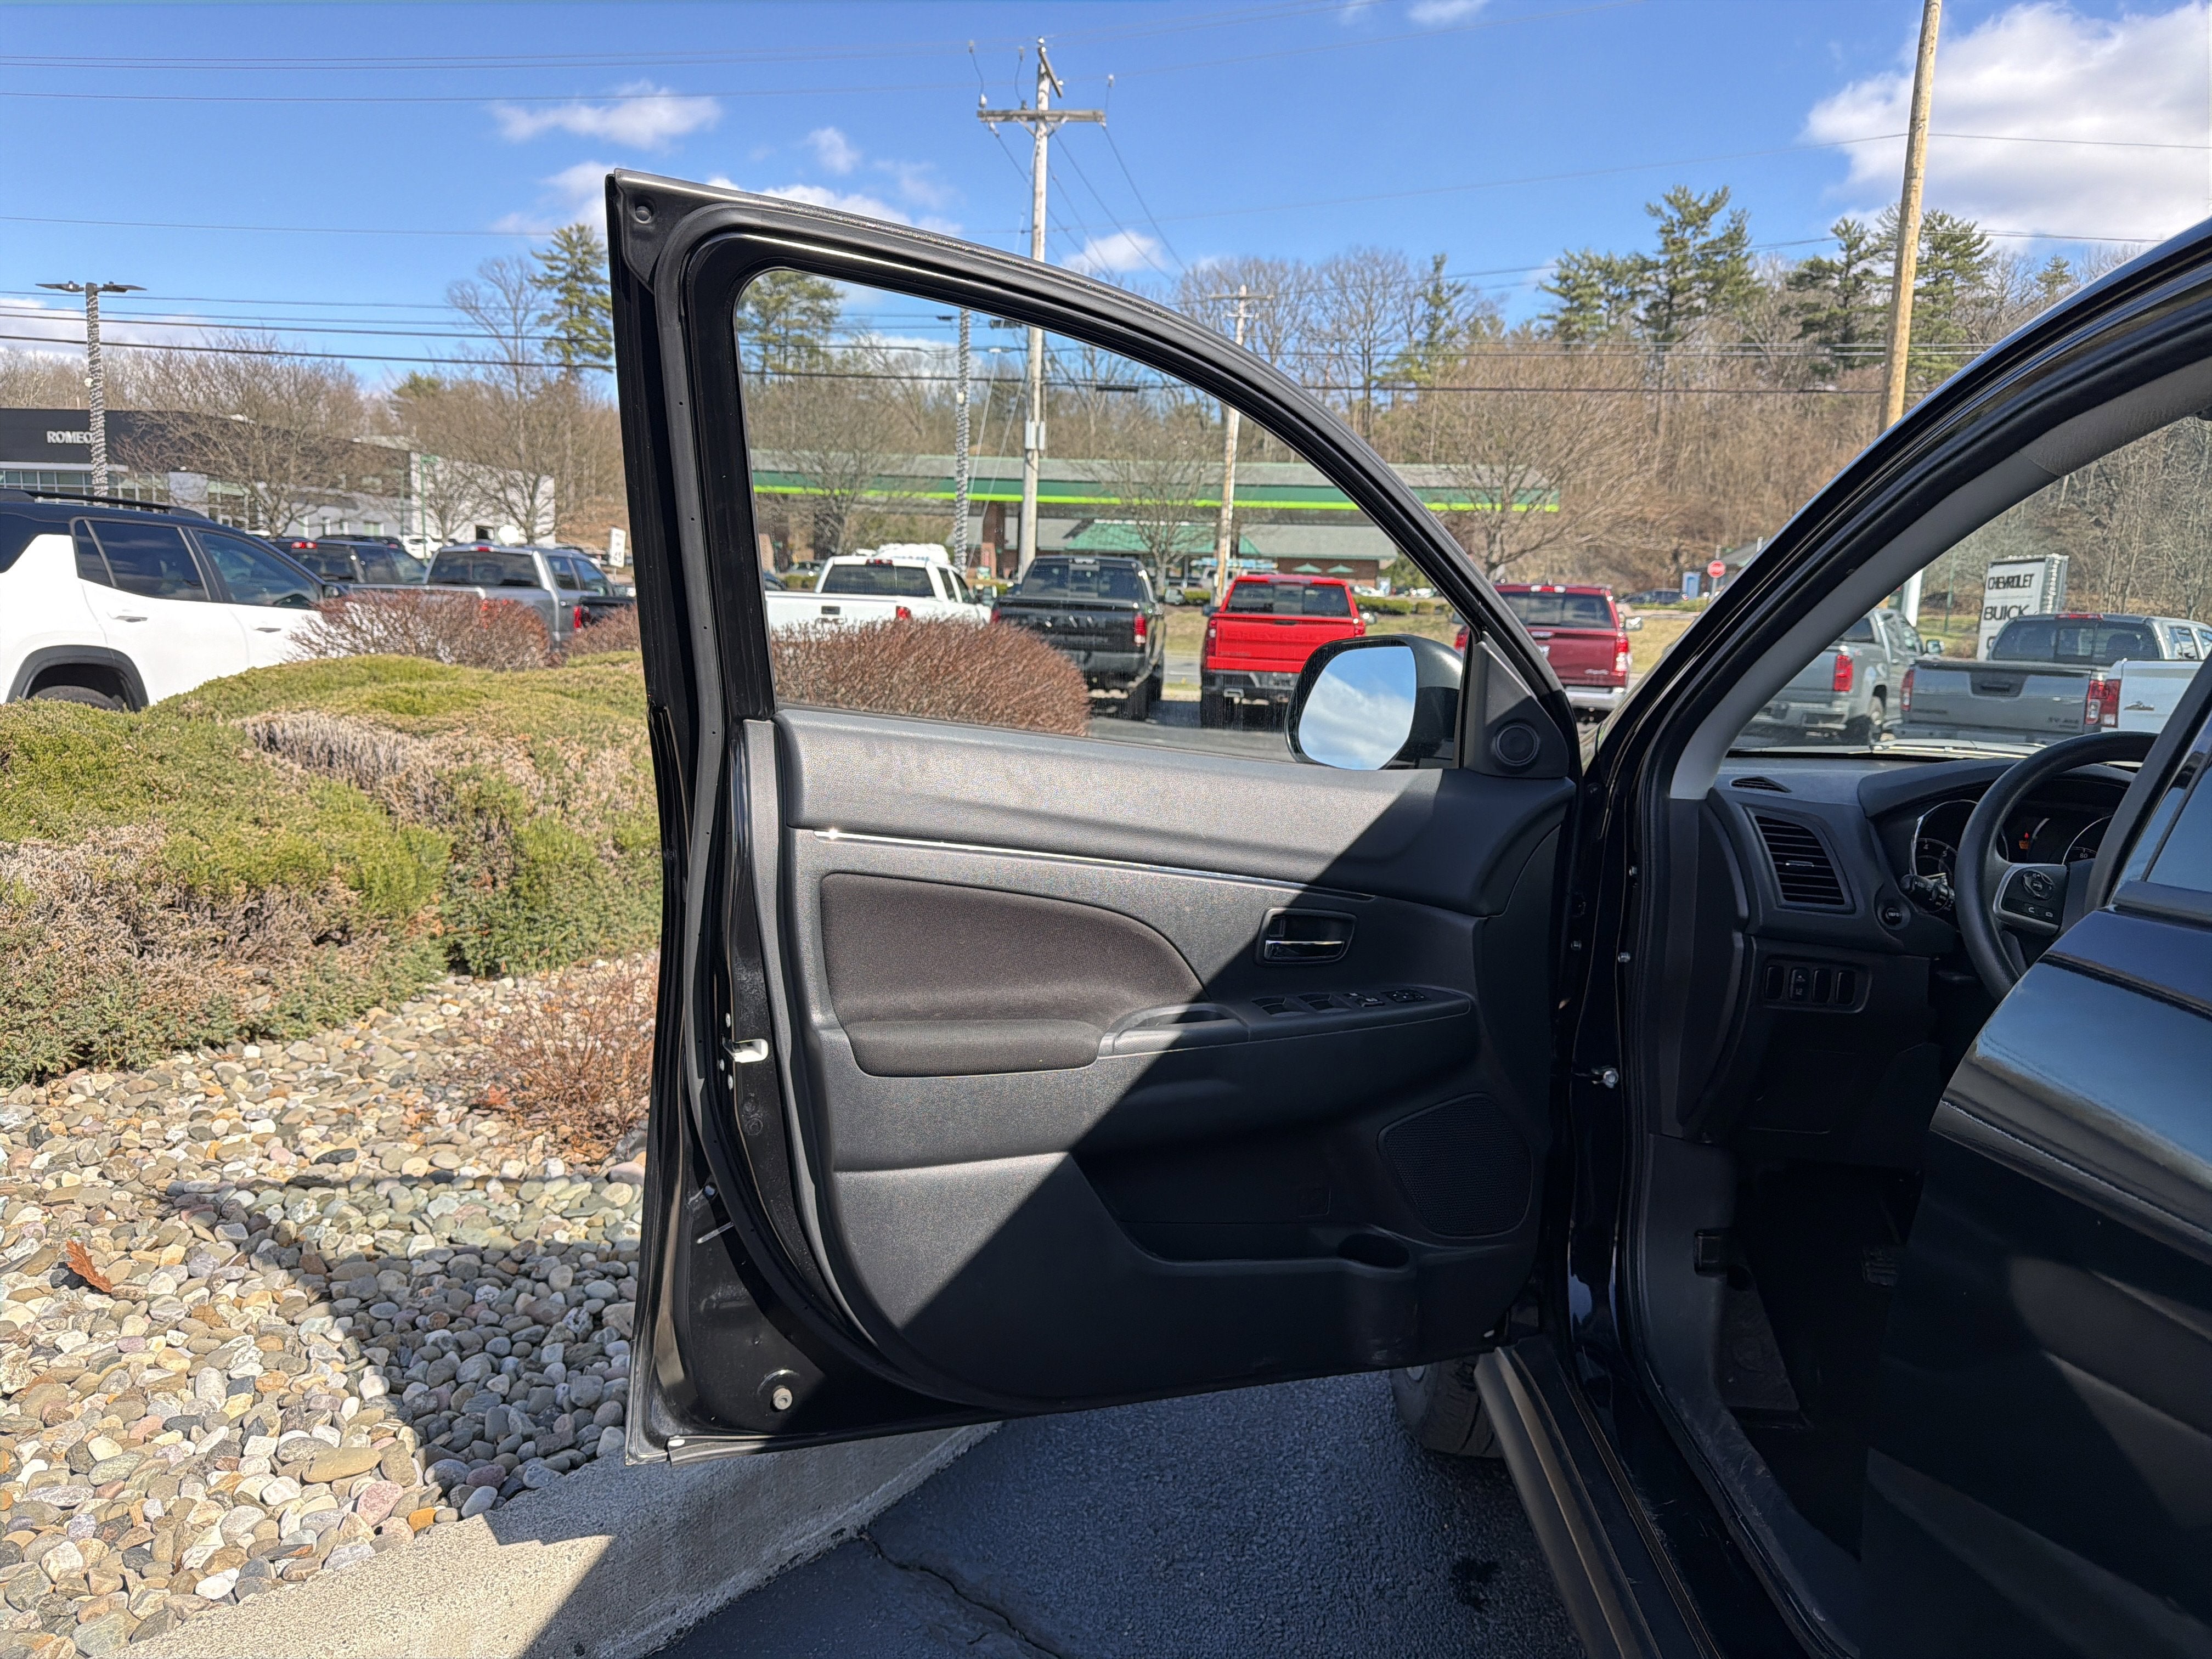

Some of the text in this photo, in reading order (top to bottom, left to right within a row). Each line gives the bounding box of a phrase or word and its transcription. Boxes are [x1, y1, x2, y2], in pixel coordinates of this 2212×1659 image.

[47, 431, 93, 444] ROMEO
[1988, 573, 2034, 590] CHEVROLET
[1983, 604, 2029, 620] BUICK
